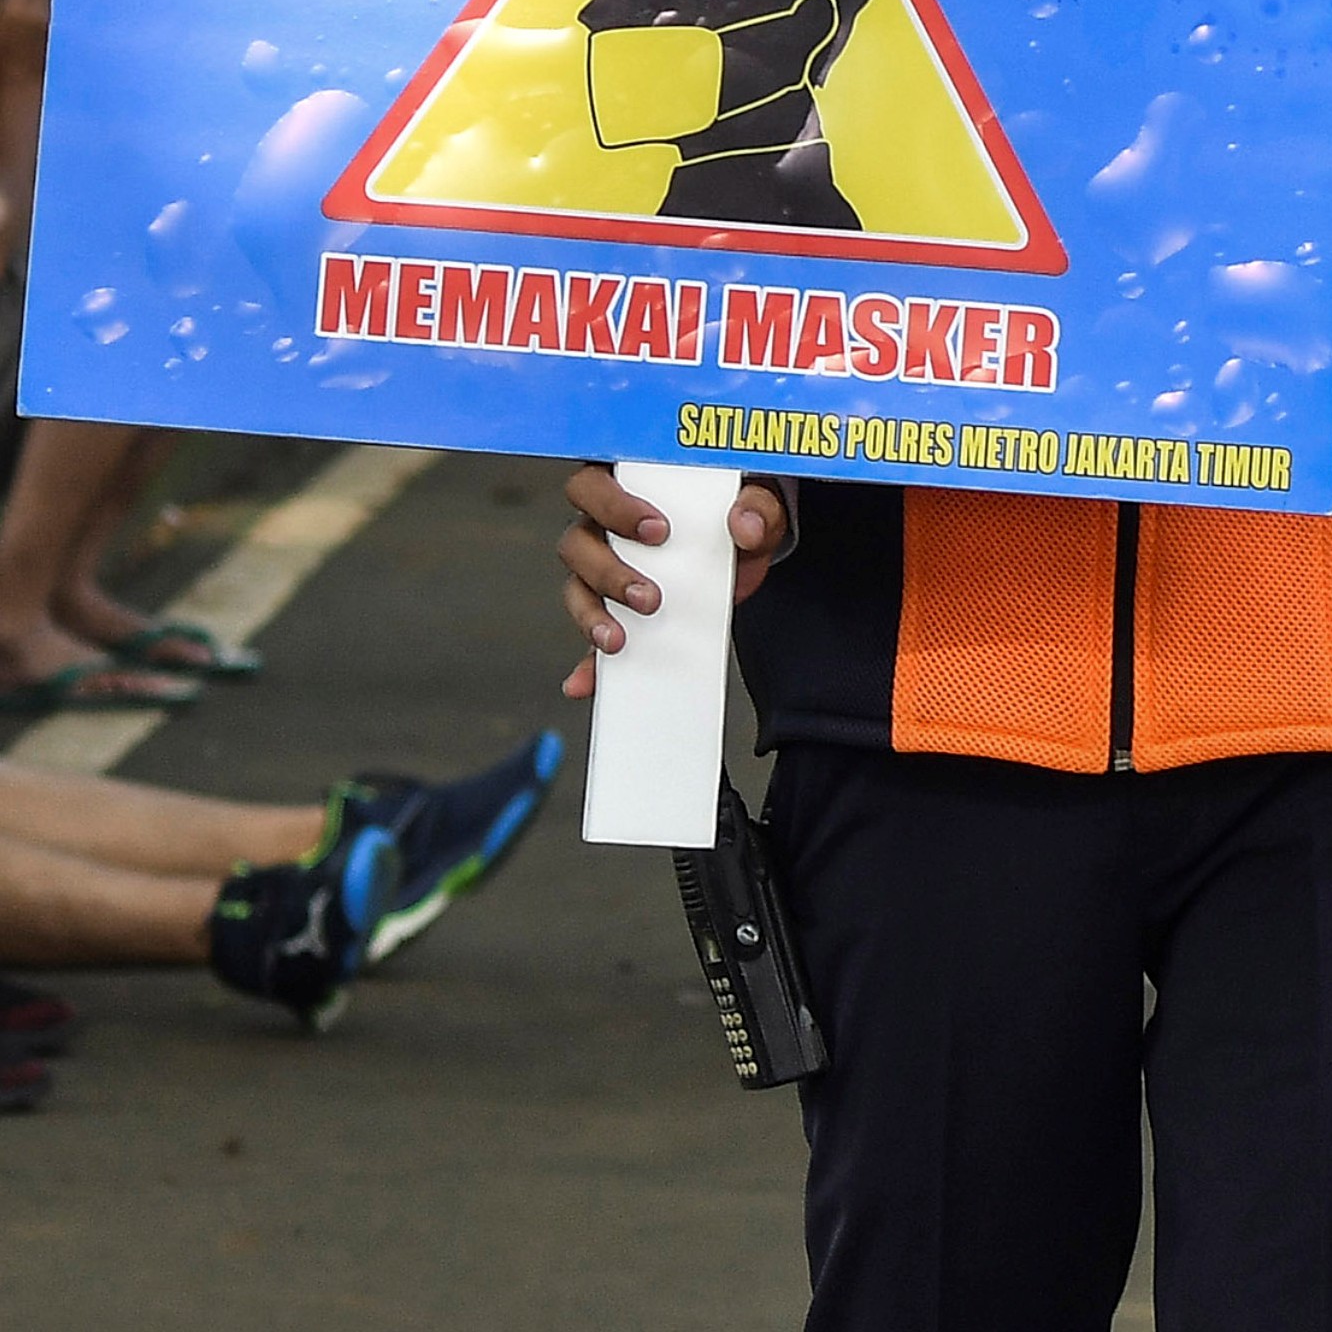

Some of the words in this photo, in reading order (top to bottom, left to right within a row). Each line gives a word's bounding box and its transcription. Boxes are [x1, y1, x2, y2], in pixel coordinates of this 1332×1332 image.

[315, 252, 706, 366] MEMAKAI
[718, 283, 1060, 393] MASKER
[678, 403, 840, 458] SATLANTAS
[844, 416, 953, 467] POLRES
[959, 424, 1060, 475] METRO
[1063, 432, 1190, 484] JAKARTA
[1196, 442, 1292, 491] TIMUR
